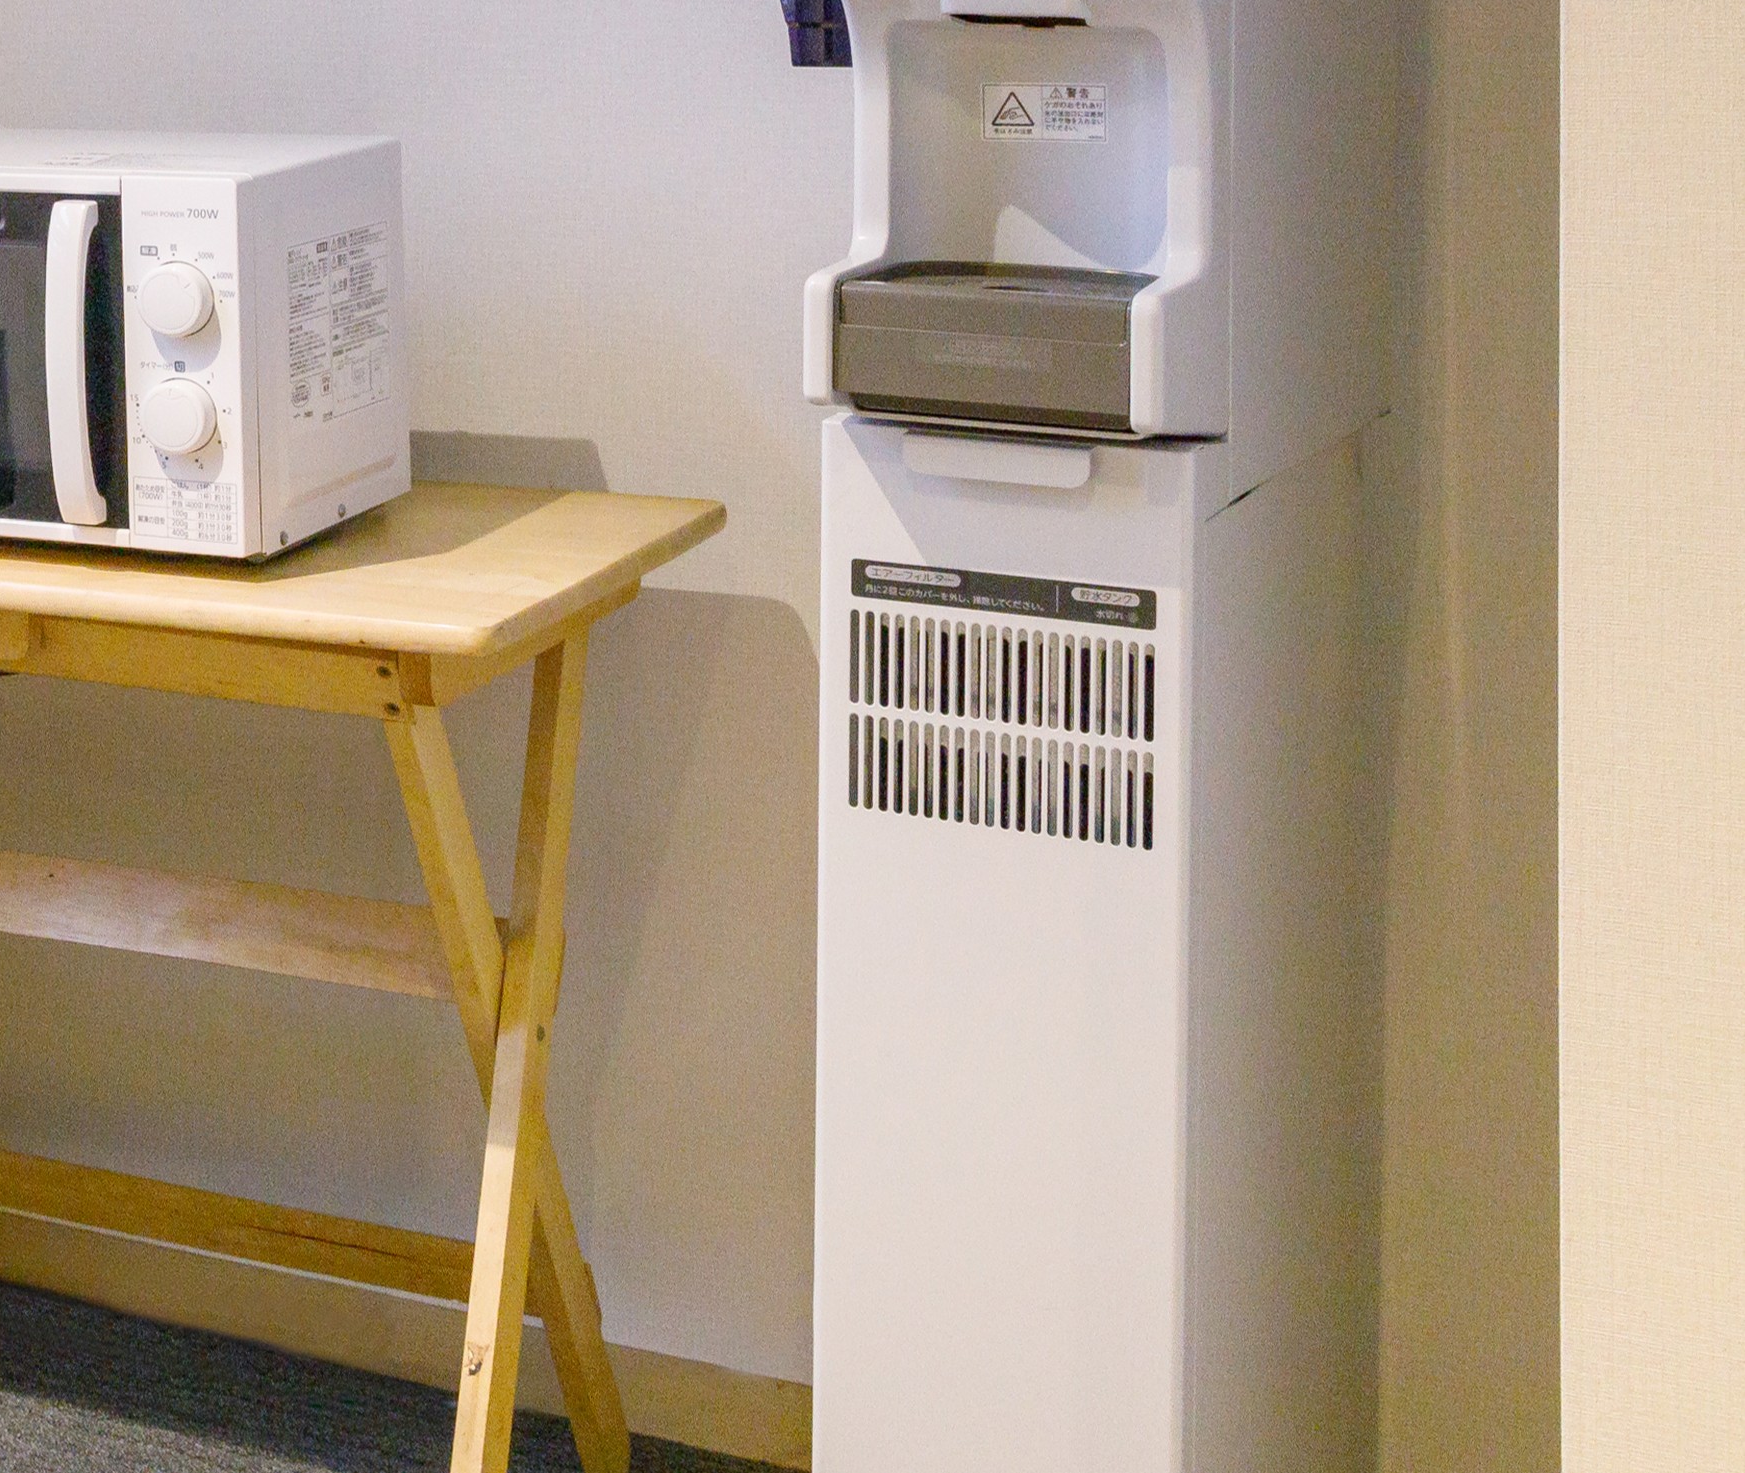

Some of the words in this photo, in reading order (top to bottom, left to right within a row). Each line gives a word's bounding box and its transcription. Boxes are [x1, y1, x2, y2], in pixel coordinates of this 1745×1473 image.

[186, 208, 219, 219] 700W
[198, 251, 214, 260] 500W
[871, 568, 954, 585] エアーフィルター
[1080, 590, 1133, 605] 貯水タンク
